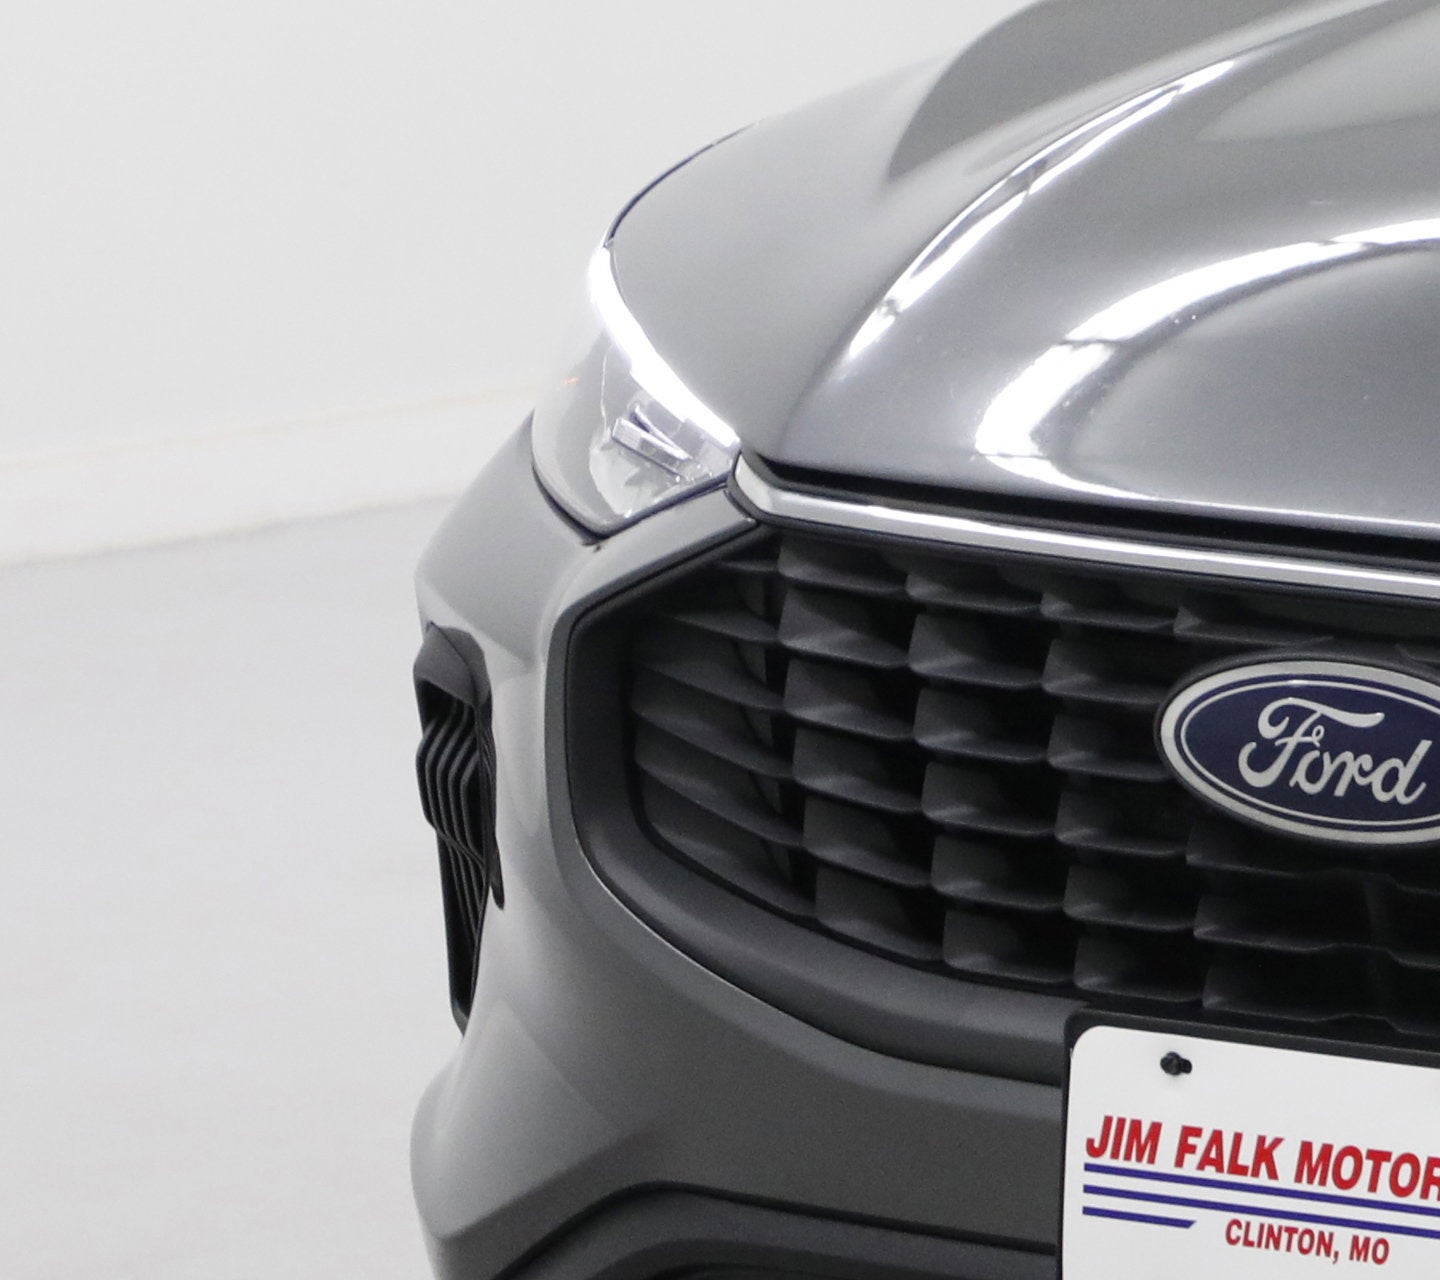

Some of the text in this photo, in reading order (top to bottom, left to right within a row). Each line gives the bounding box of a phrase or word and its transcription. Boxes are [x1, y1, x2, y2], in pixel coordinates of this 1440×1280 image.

[1238, 697, 1432, 804] Ford
[1085, 1114, 1162, 1165] JIM
[1173, 1124, 1285, 1181] FALK
[1225, 1218, 1390, 1266] CLINTON, MO
